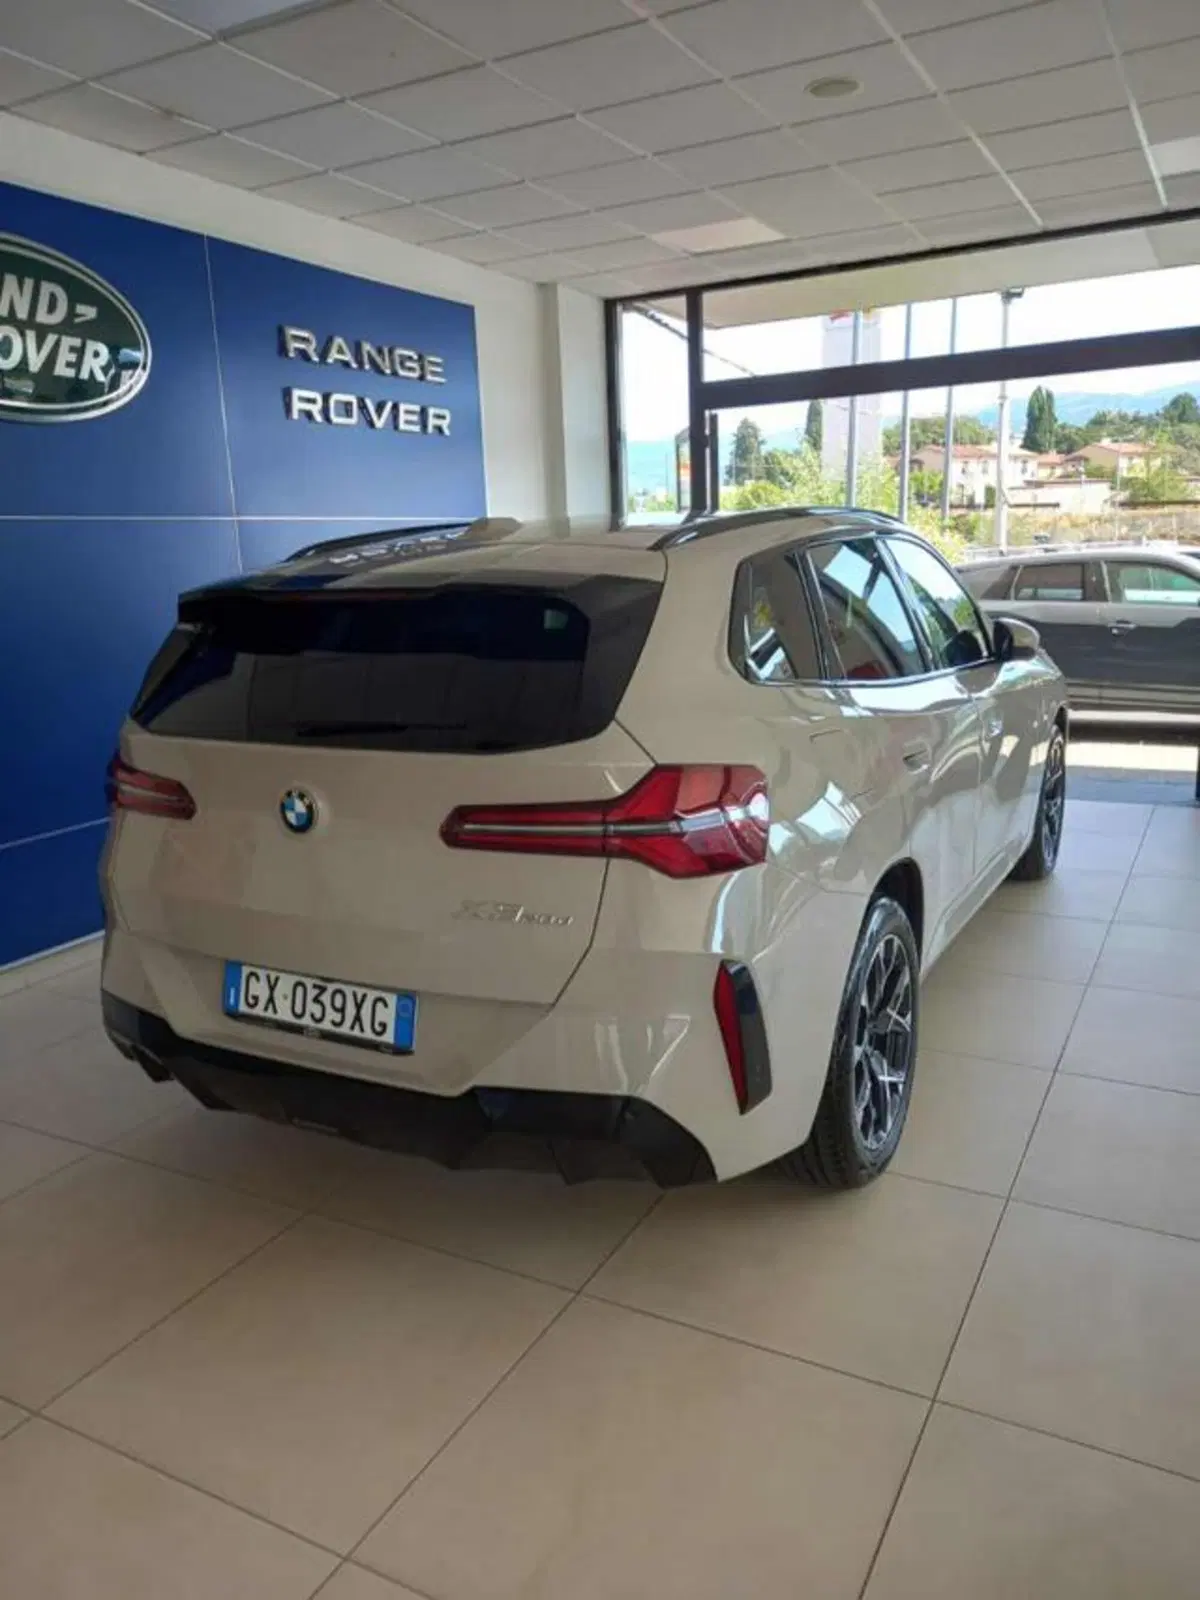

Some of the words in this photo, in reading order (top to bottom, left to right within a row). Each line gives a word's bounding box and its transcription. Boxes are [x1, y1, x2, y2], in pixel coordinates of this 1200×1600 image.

[0, 273, 68, 325] ND
[0, 325, 109, 382] OVER
[279, 325, 447, 384] RANGE
[286, 387, 451, 436] ROVER
